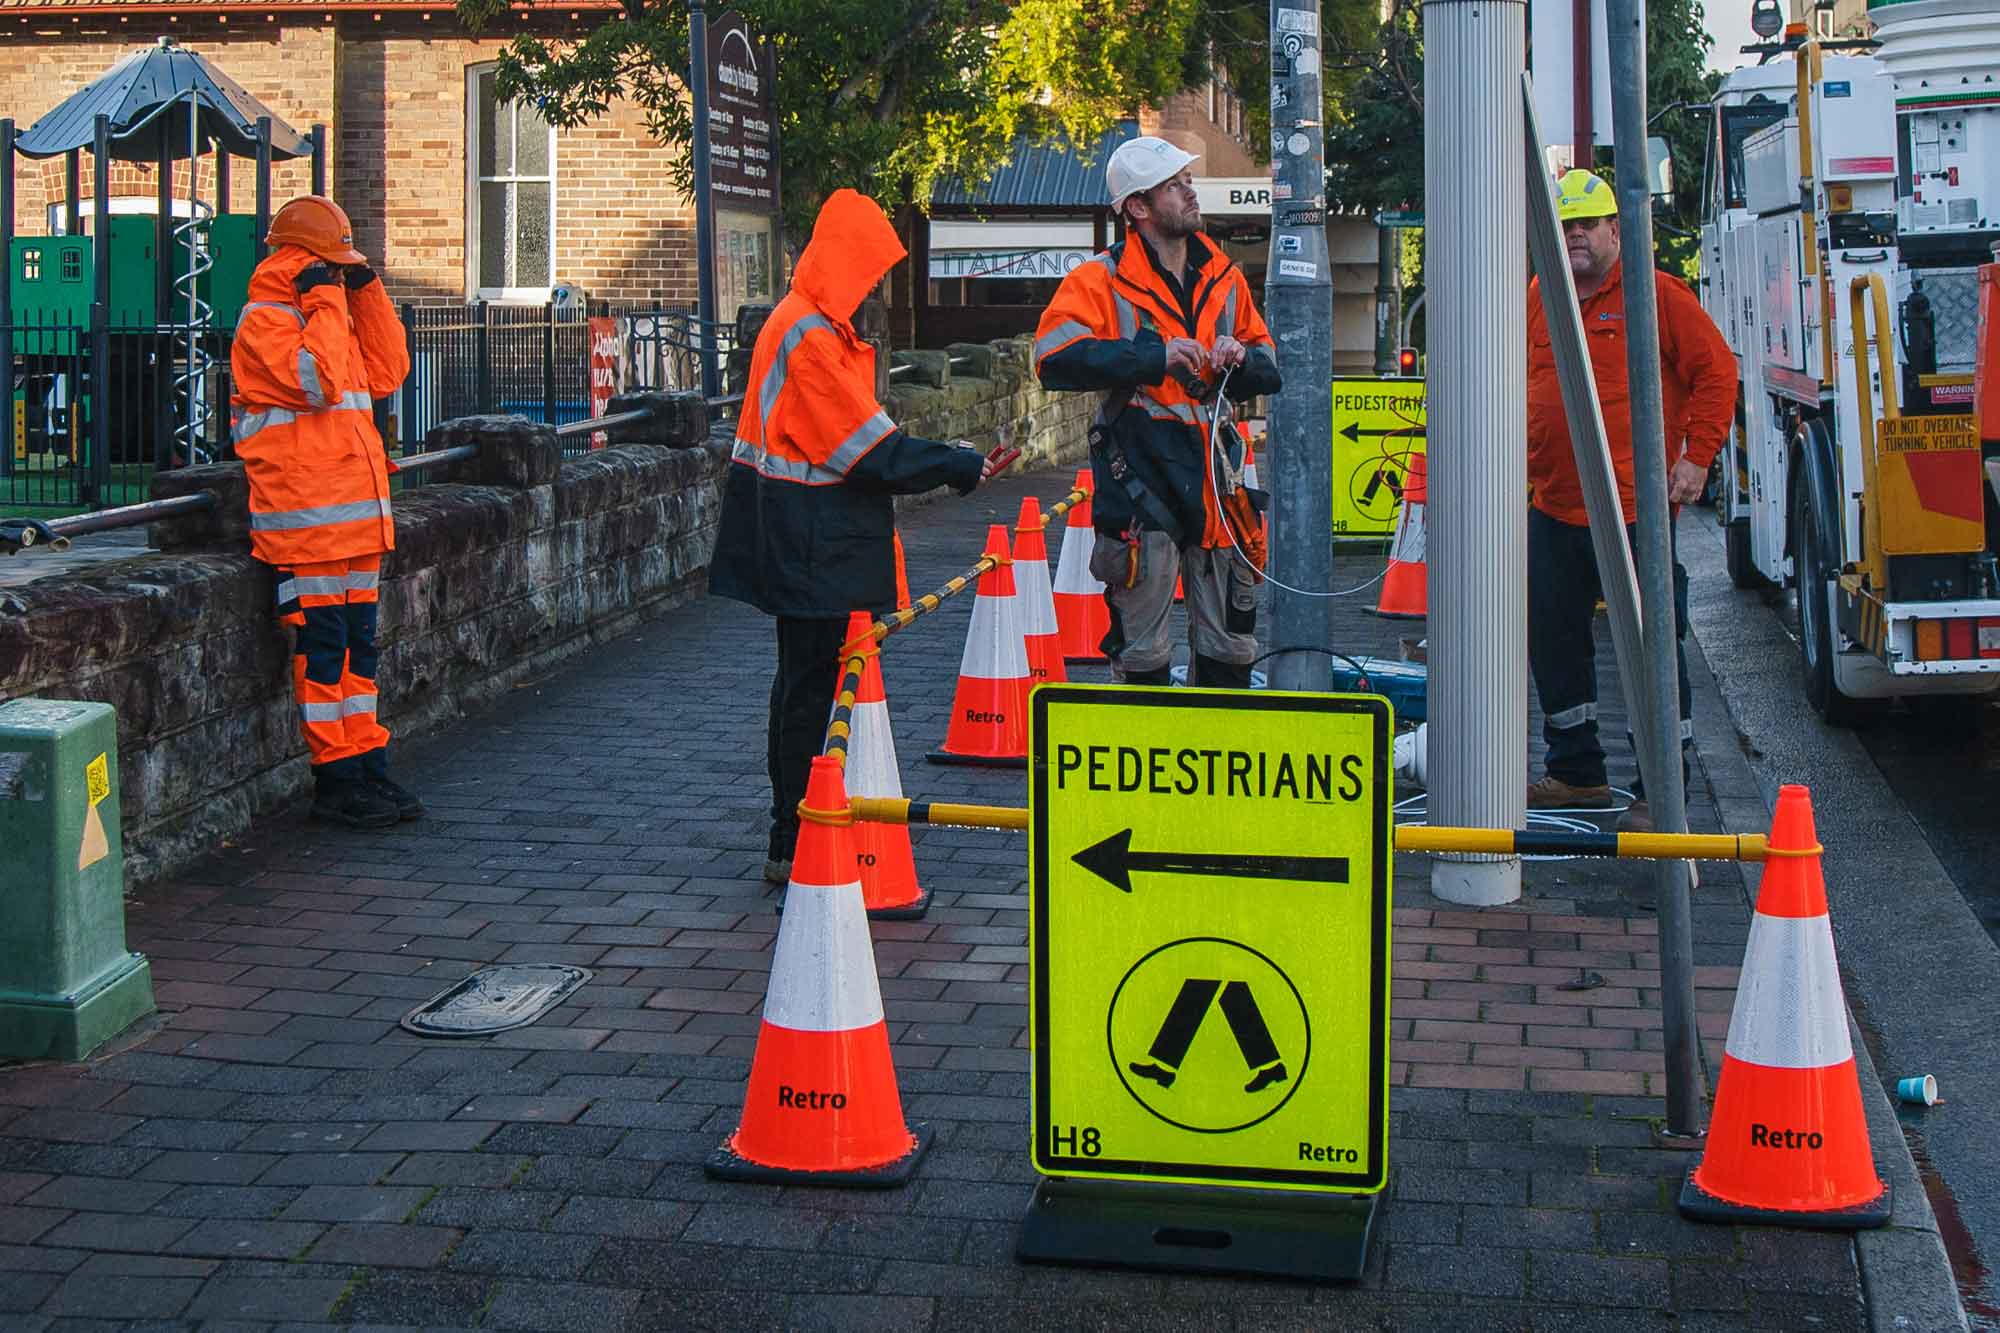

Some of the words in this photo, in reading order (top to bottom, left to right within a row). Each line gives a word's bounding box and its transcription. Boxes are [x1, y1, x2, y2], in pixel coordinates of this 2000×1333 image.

[1230, 190, 1270, 204] BAR
[944, 252, 1086, 275] ITALIANO
[1936, 385, 1975, 395] WARNIN
[1335, 395, 1425, 411] PEDESTRIAN
[1884, 421, 1896, 433] DO
[1902, 420, 1919, 433] NOT
[1924, 417, 1975, 433] OVERTAKE
[1885, 436, 1927, 451] TURNING
[1932, 434, 1974, 449] VEHICLE
[1030, 667, 1047, 678] tro
[966, 709, 1005, 724] Retro
[1057, 744, 1362, 802] PEDESTRIANS
[778, 1086, 847, 1110] Retro
[1051, 1126, 1102, 1158] H8
[1751, 1123, 1823, 1149] Retro
[1299, 1142, 1358, 1164] Retro
